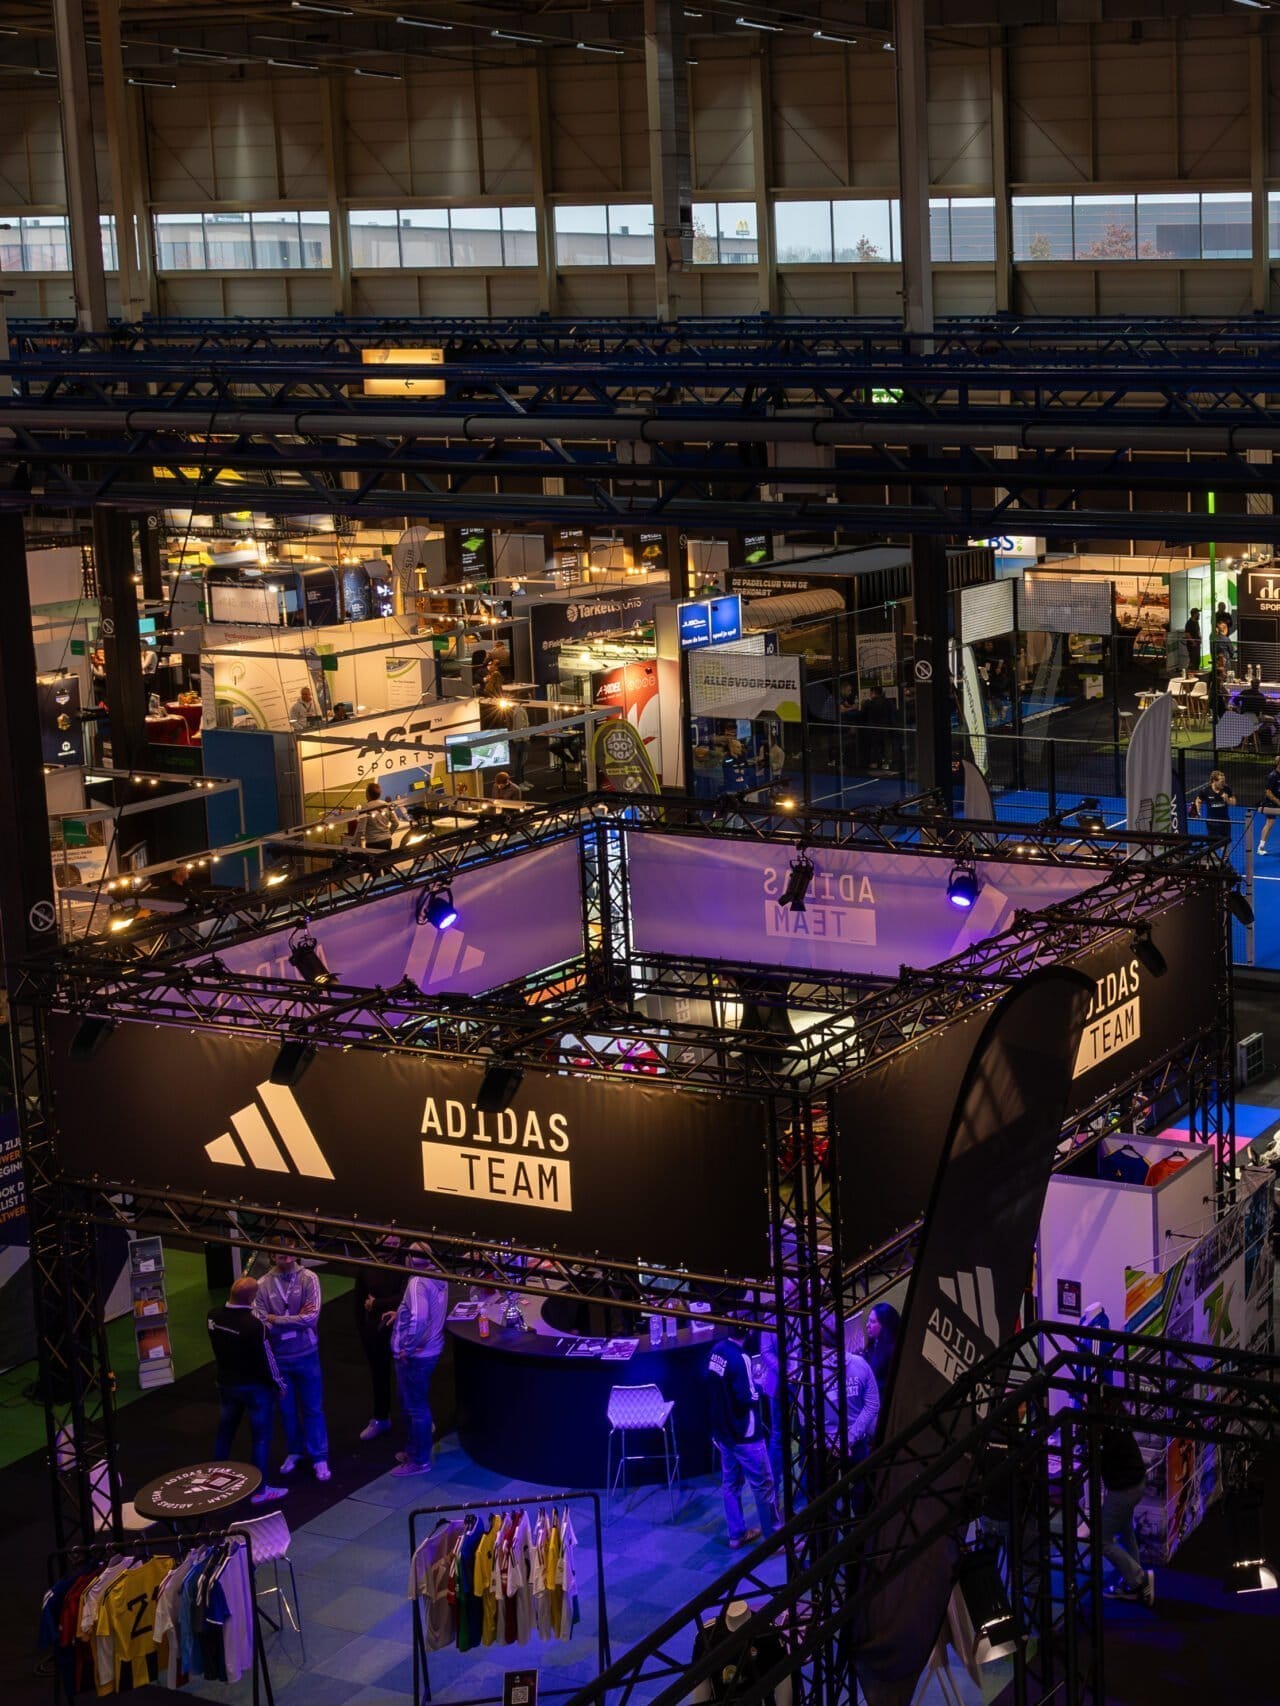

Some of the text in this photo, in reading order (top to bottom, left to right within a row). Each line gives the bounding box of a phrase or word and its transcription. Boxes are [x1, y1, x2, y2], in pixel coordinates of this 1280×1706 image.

[703, 675, 798, 690] ALLESVOORPADEL
[357, 751, 434, 776] SPORTS
[1090, 1005, 1135, 1059] TEAM
[421, 1097, 570, 1152] ADIDAS
[461, 1153, 559, 1202] TEAM
